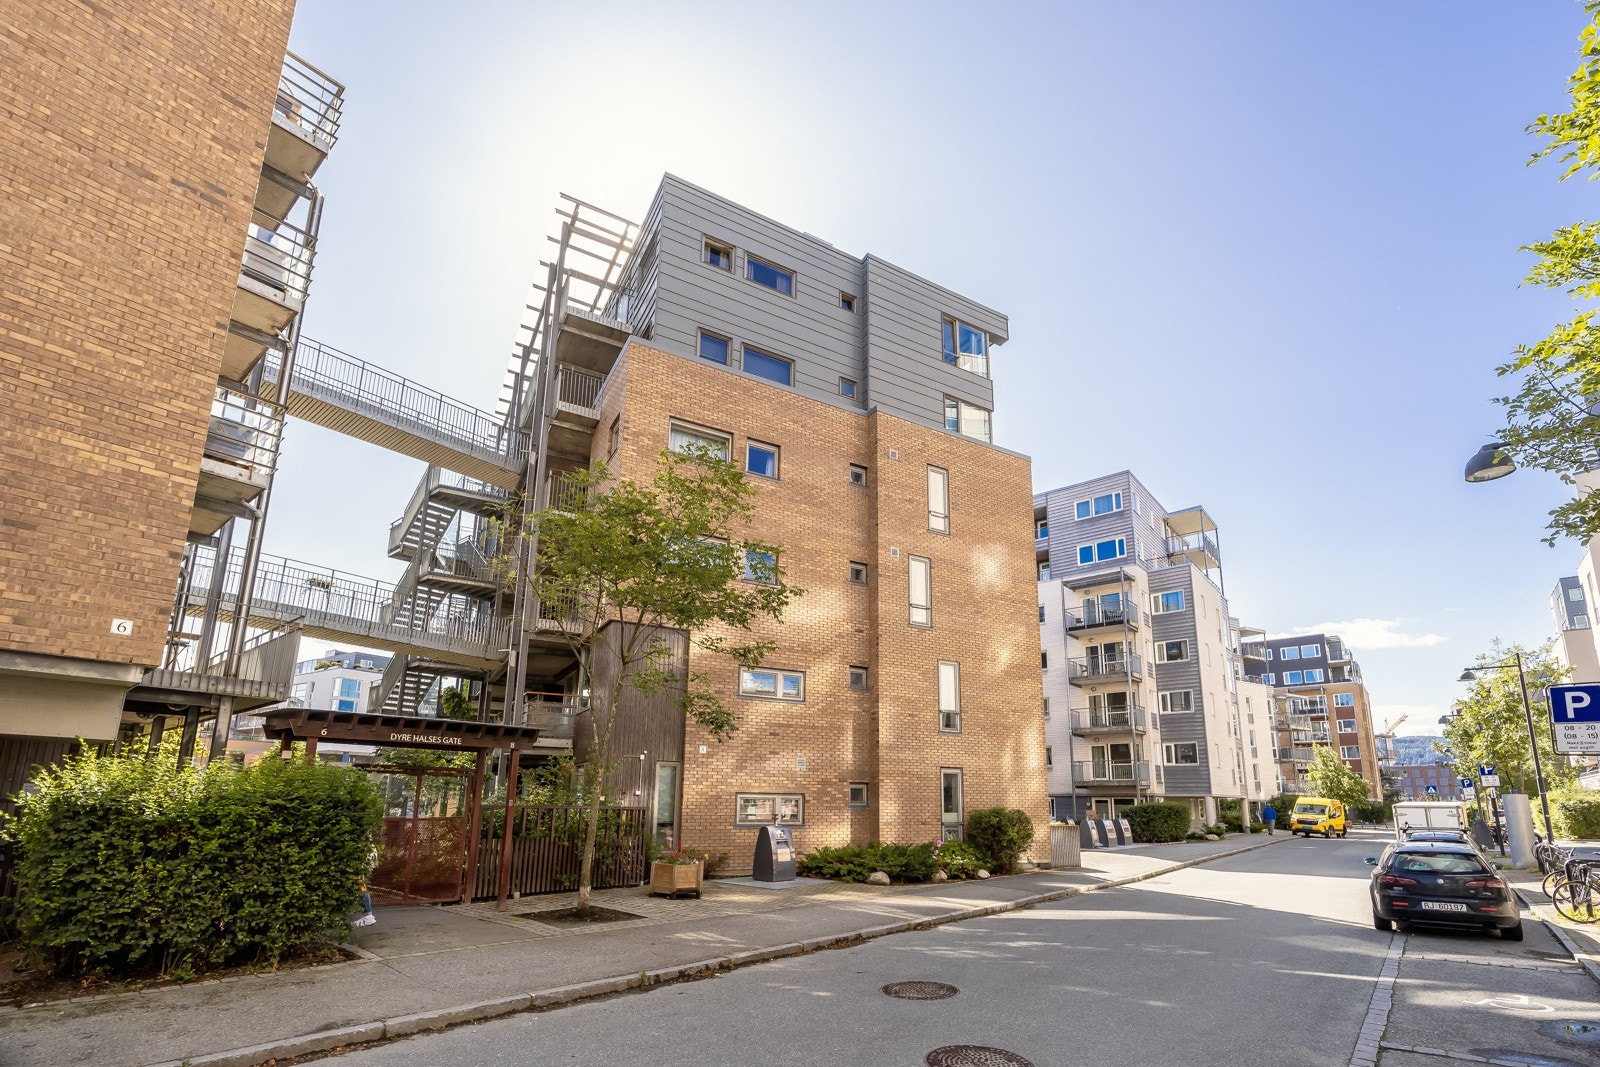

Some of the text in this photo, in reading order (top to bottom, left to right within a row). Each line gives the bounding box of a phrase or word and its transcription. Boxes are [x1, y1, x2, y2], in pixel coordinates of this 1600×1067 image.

[117, 622, 127, 633] 6
[1564, 691, 1591, 718] P
[321, 728, 328, 736] 6
[390, 733, 462, 745] DYRE HALSES GATE
[510, 741, 515, 749] 8
[1463, 779, 1470, 787] P
